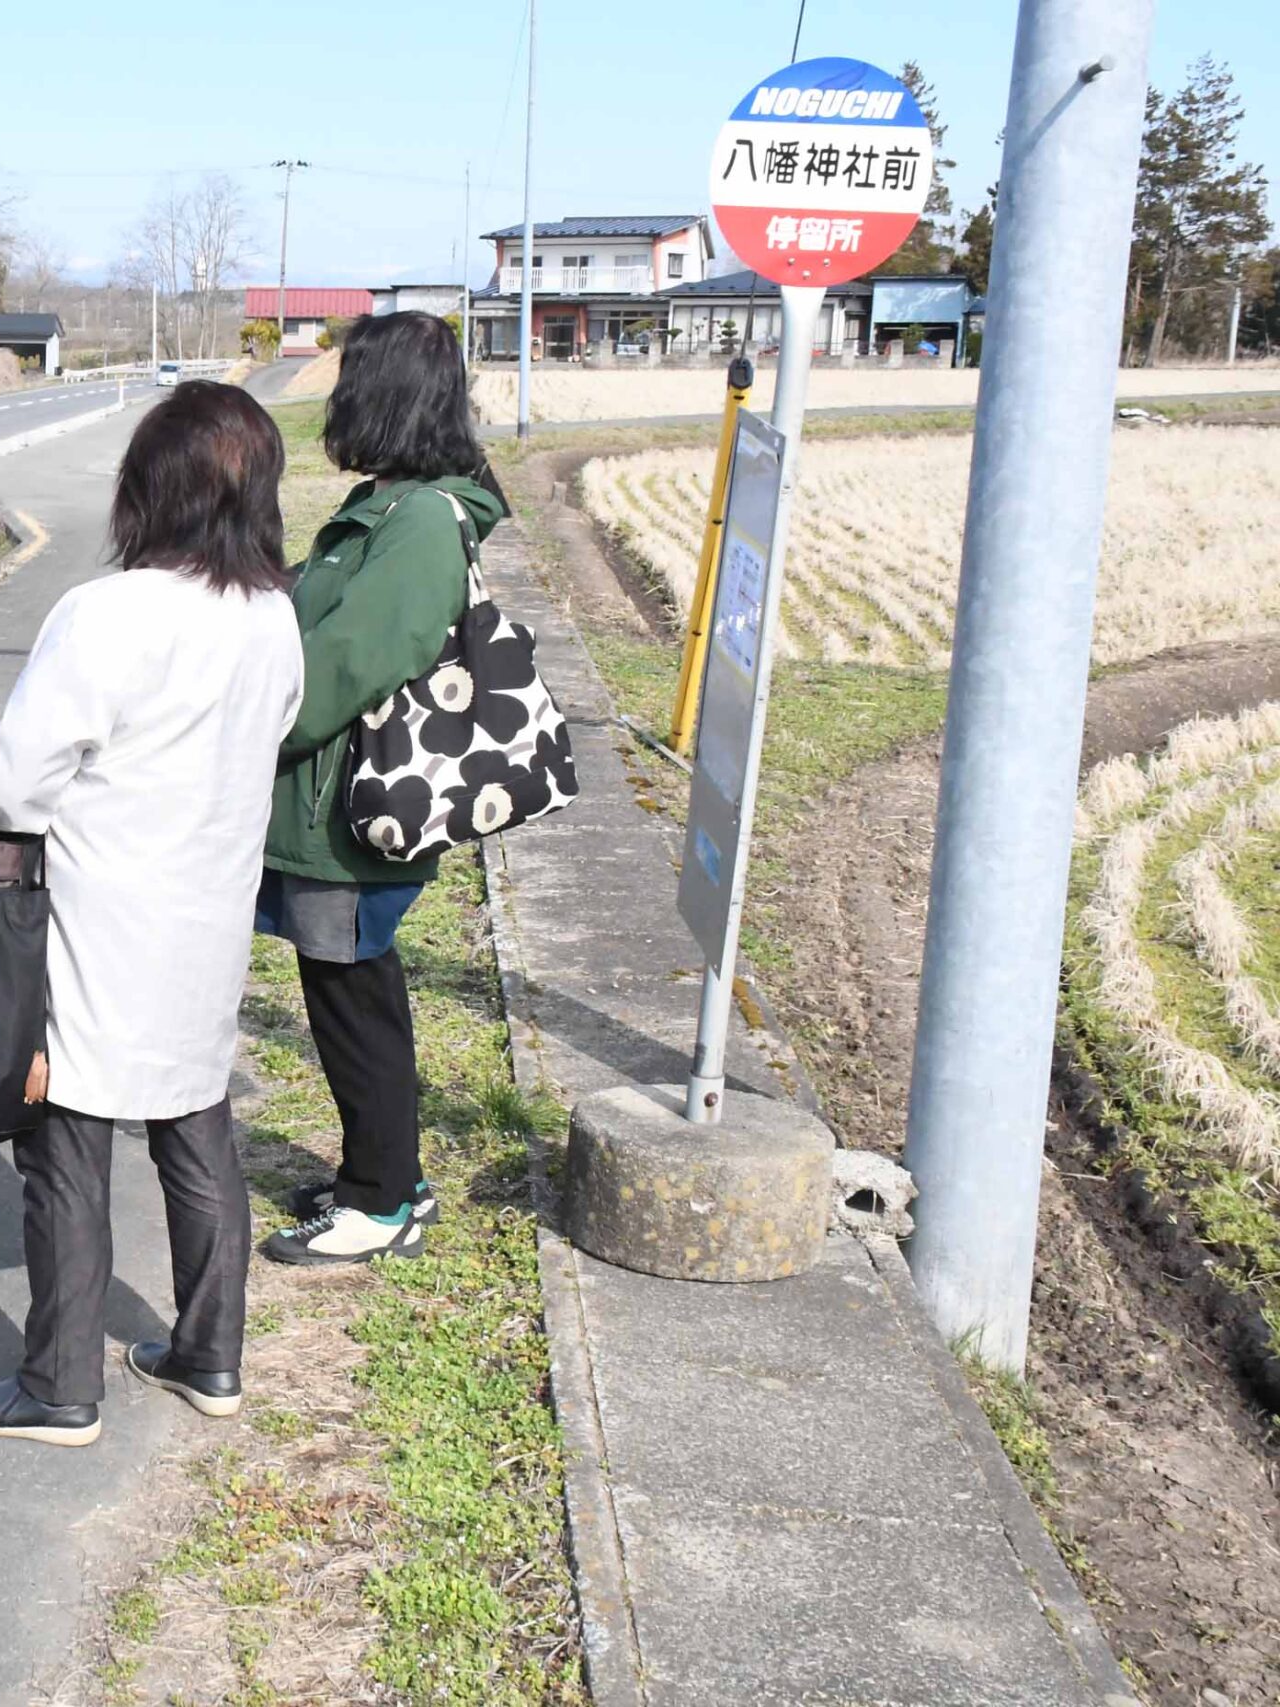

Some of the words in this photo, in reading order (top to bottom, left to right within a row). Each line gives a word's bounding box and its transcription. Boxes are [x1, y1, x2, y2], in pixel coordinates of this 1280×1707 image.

[749, 87, 904, 119] NOGUCHI
[723, 139, 920, 191] 八幡神社前
[766, 215, 863, 252] 停留所
